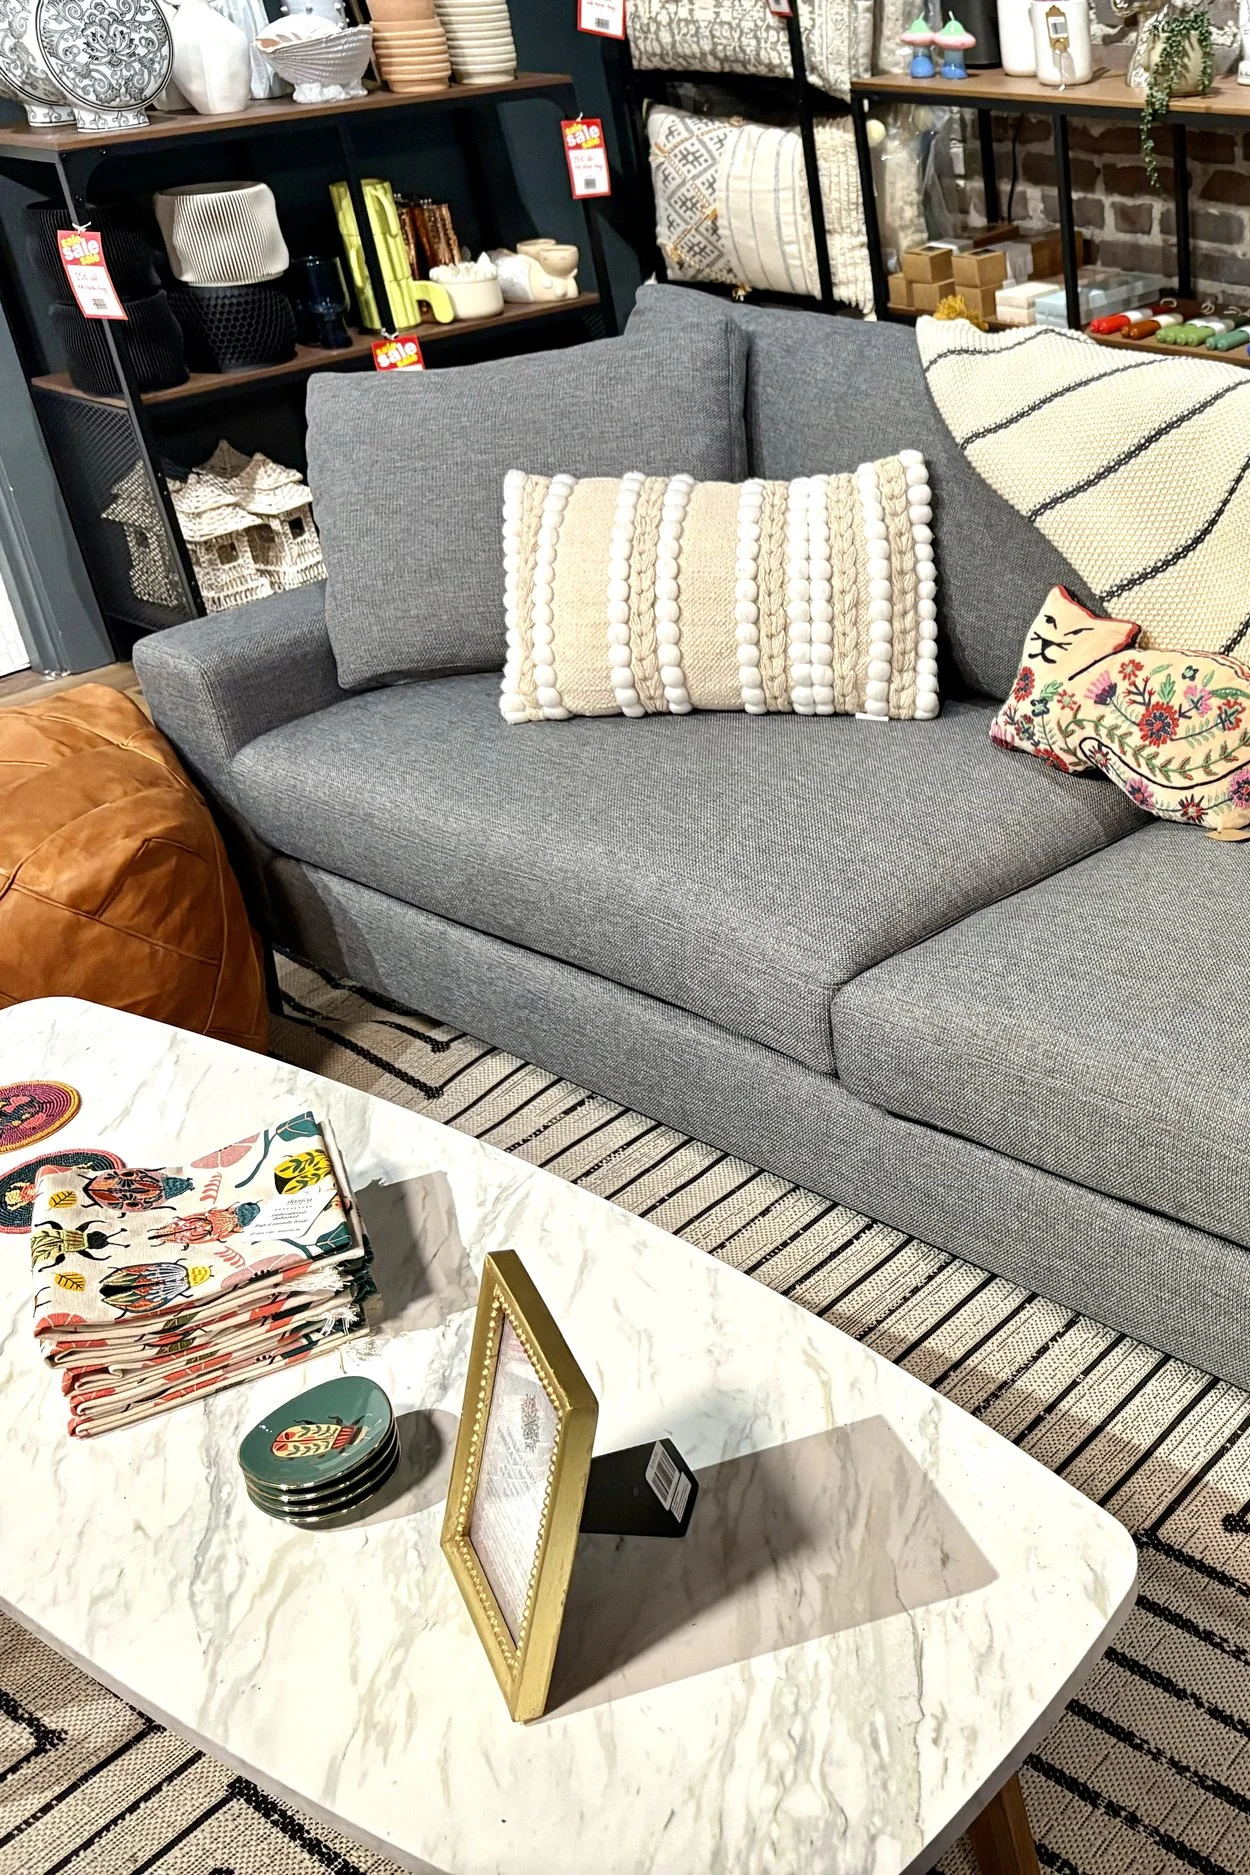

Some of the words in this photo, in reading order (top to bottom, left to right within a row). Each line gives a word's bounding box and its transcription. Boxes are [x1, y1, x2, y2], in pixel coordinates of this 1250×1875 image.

[566, 124, 600, 147] sale
[63, 238, 99, 260] sale
[377, 342, 417, 367] sale
